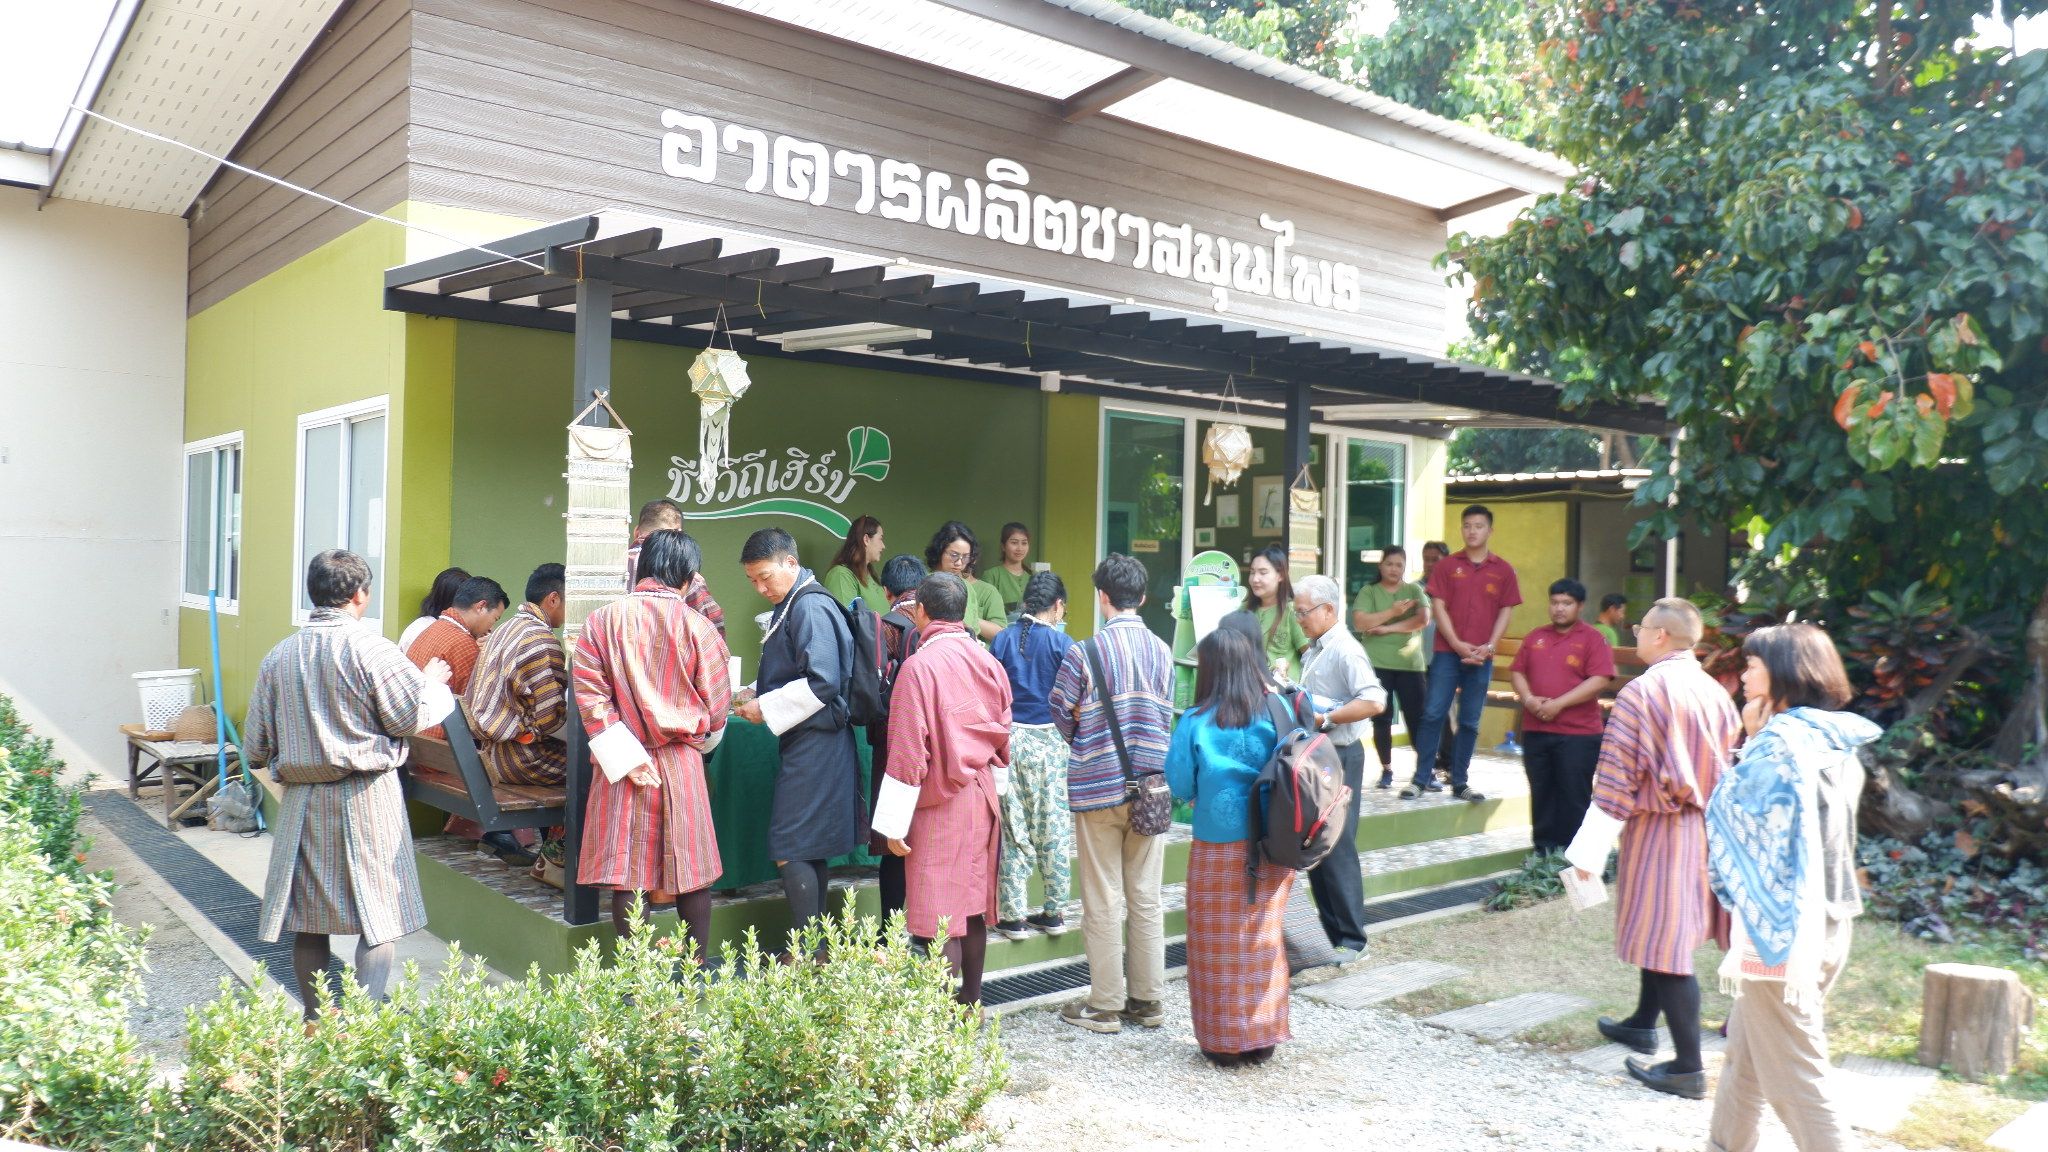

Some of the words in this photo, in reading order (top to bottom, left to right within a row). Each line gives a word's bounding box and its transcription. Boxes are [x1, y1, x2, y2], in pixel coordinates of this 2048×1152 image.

[660, 108, 1361, 312] อาคารผลิตชาสมุนไพร
